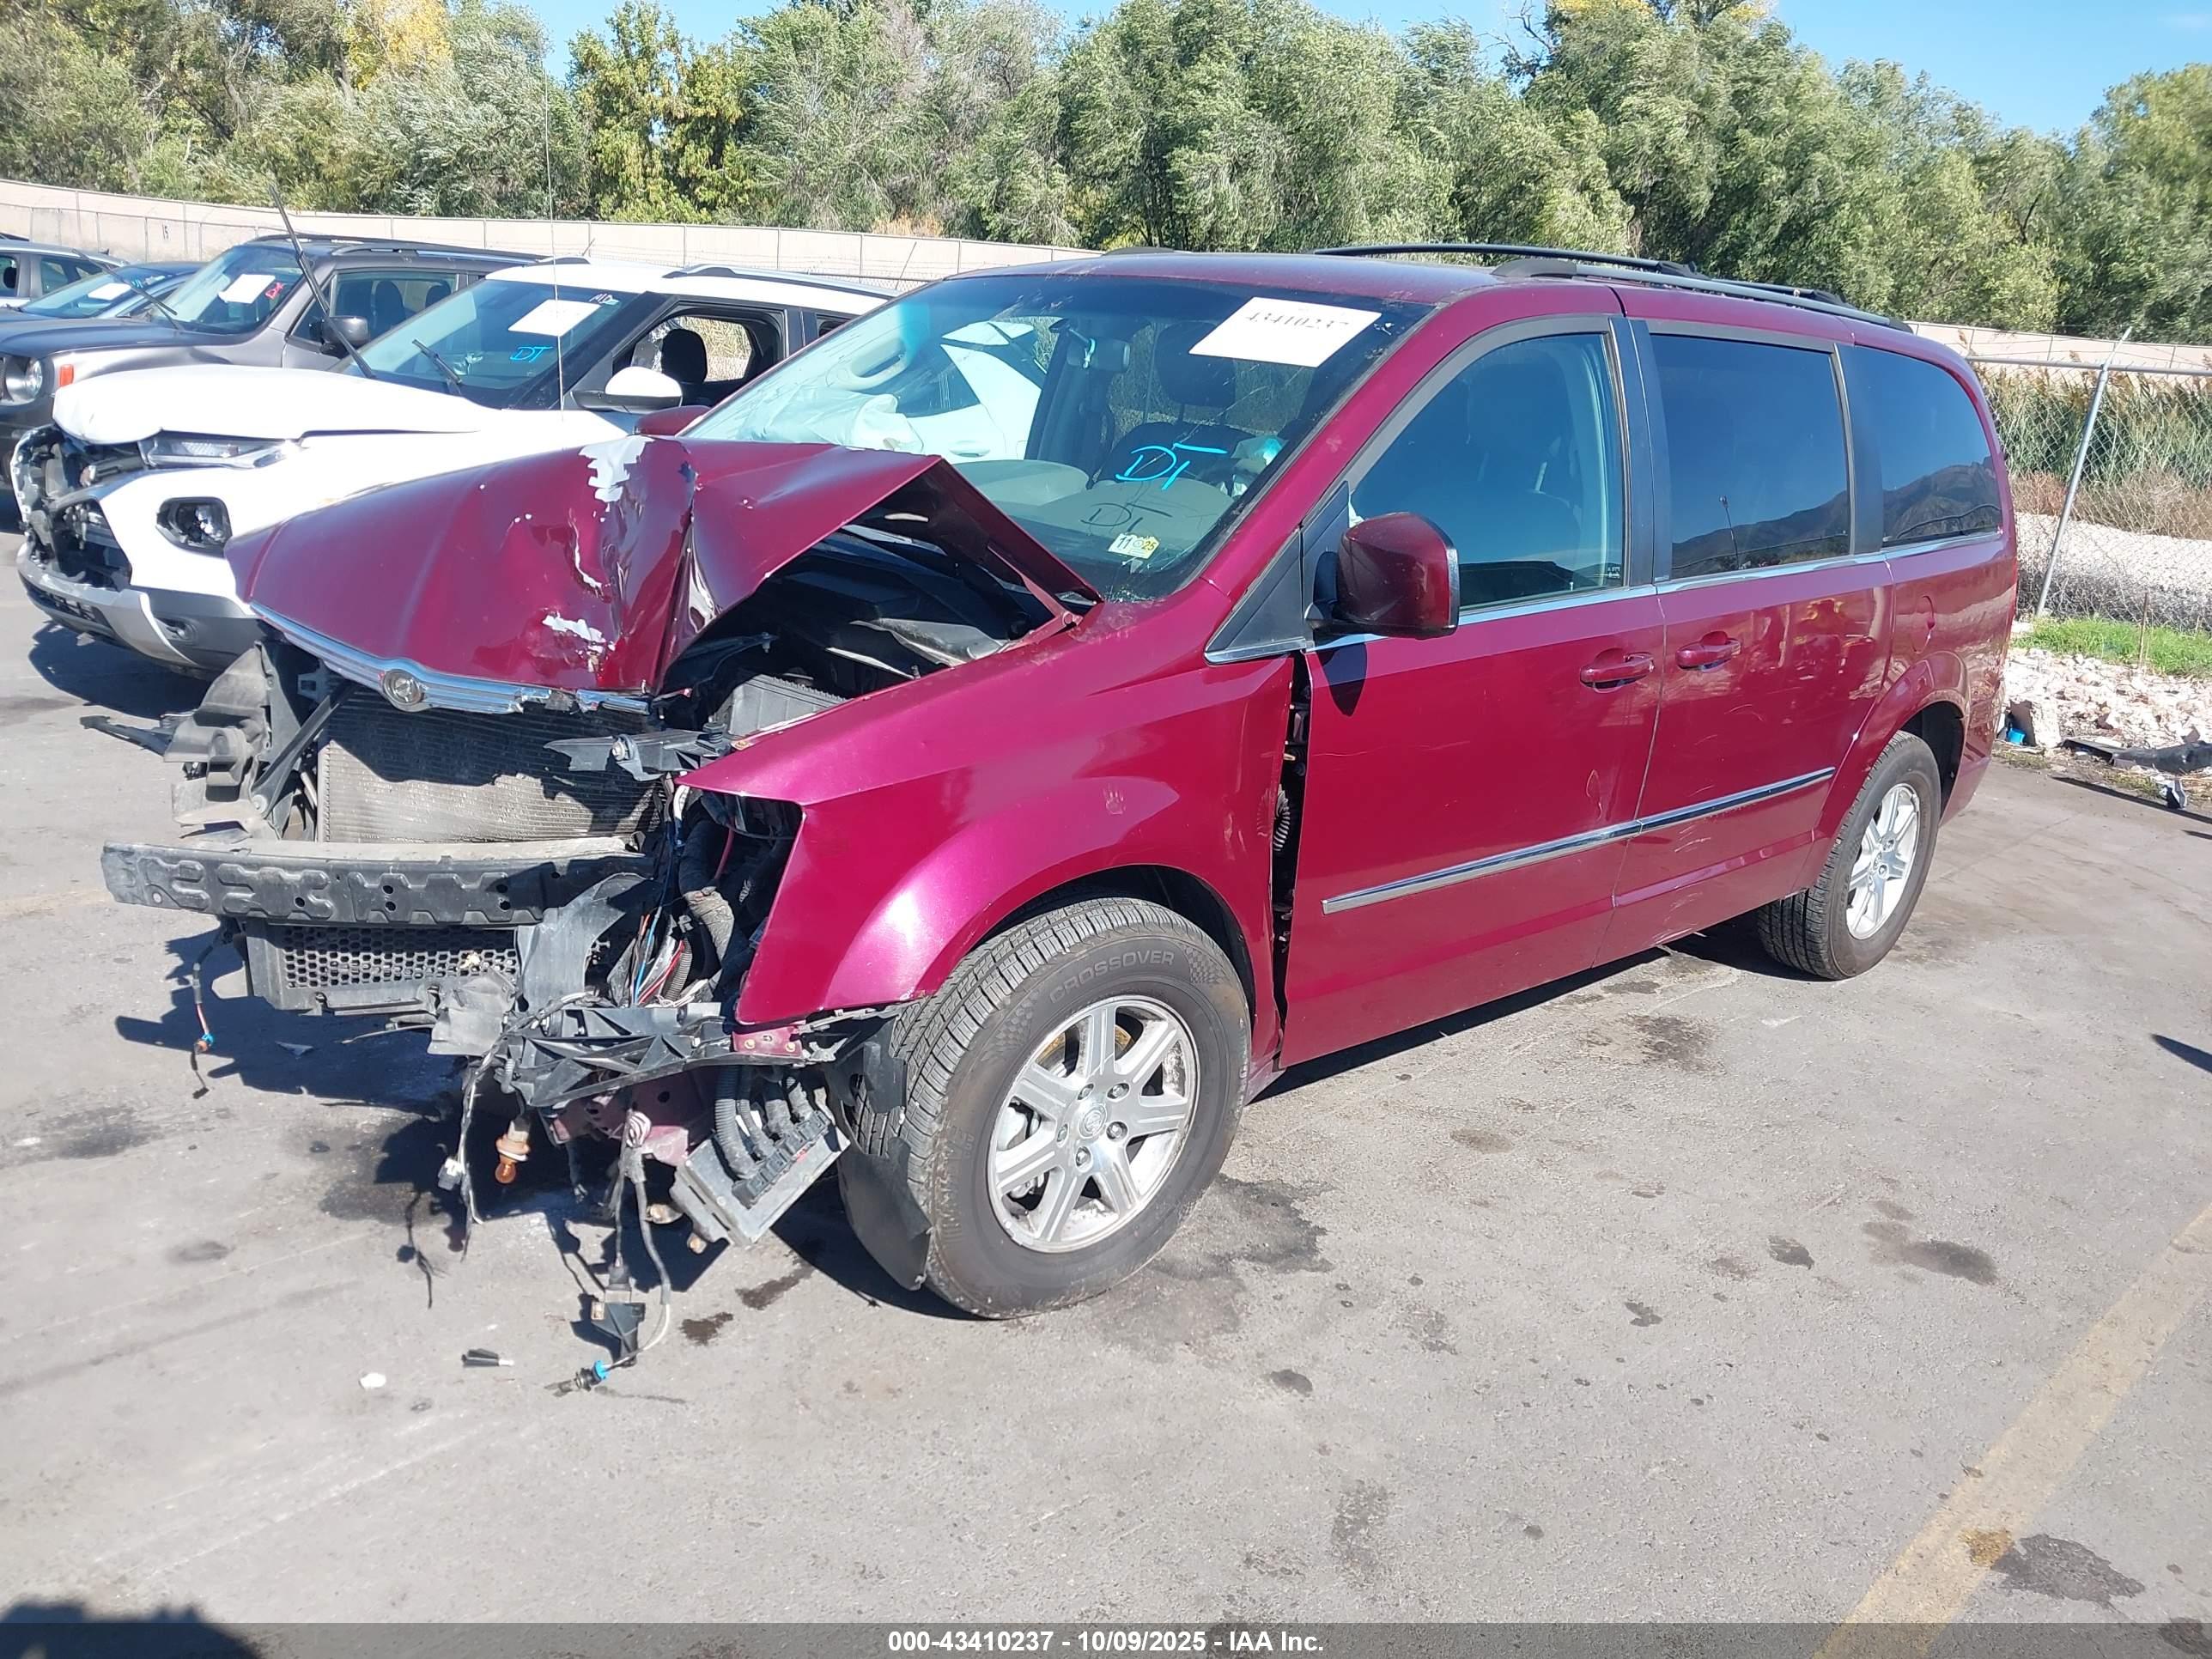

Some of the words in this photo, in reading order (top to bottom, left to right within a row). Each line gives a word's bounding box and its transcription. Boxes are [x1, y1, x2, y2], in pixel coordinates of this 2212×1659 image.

[509, 346, 554, 363] DT
[1115, 442, 1229, 491] DT
[1141, 540, 1157, 550] 25
[1049, 950, 1175, 1003] CROSSOVER
